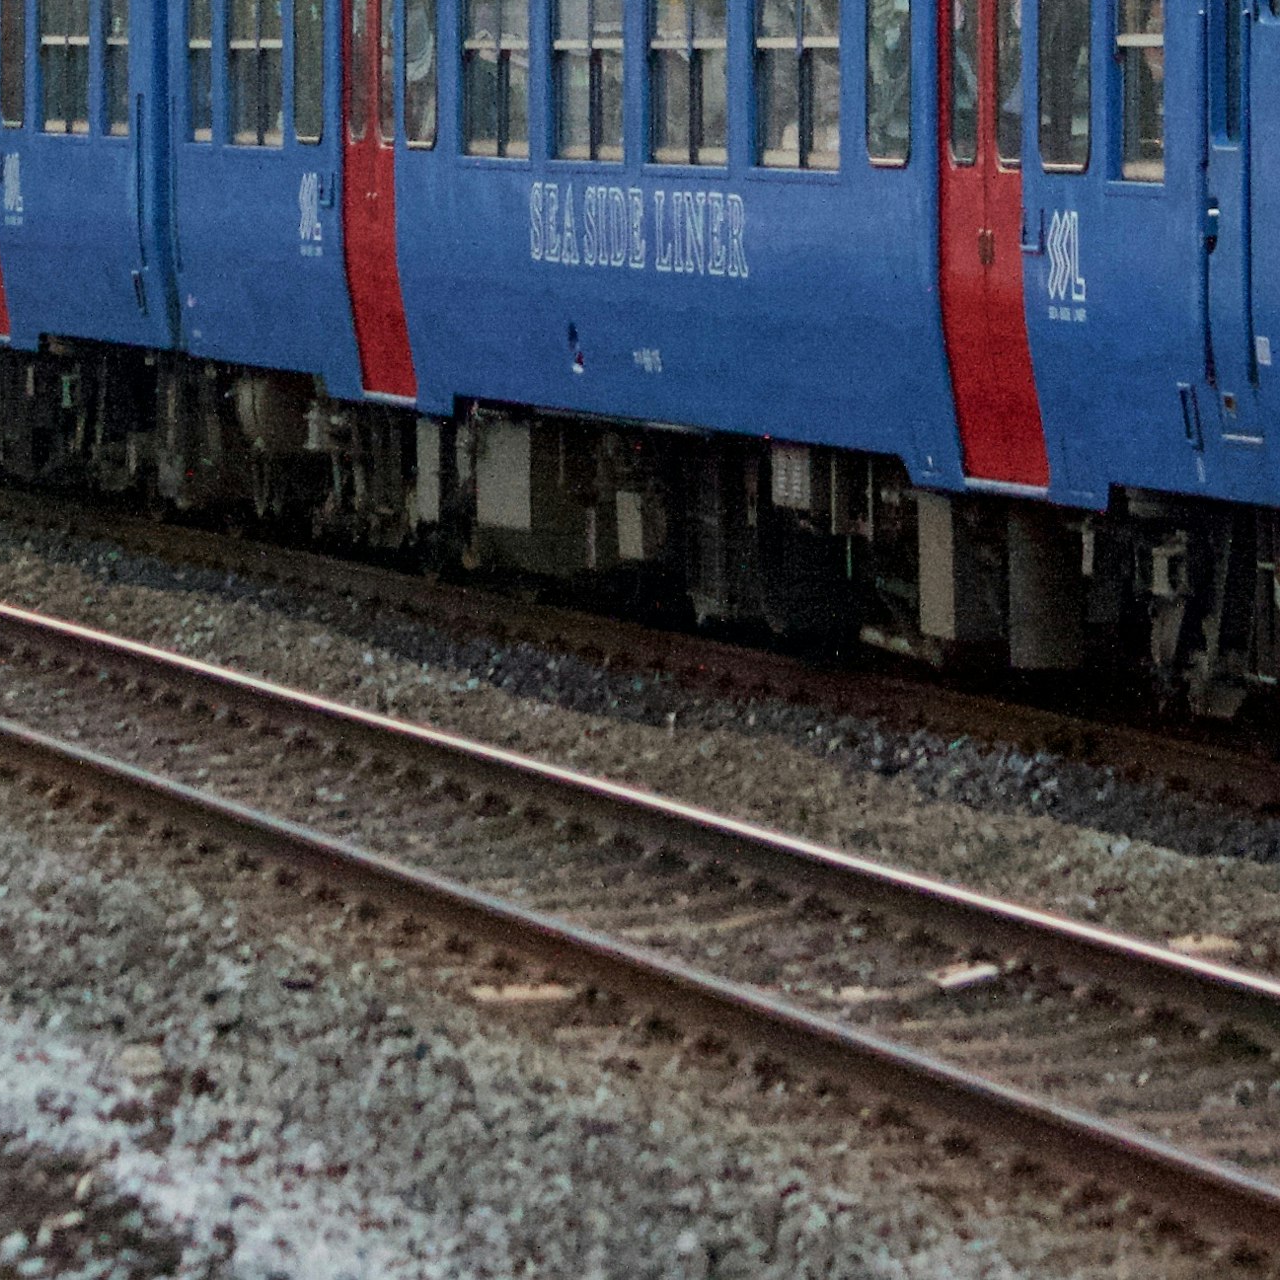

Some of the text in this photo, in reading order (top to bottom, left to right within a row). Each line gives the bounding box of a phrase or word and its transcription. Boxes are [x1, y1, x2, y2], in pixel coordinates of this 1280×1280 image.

[530, 181, 749, 279] SEA SIDE LINER
